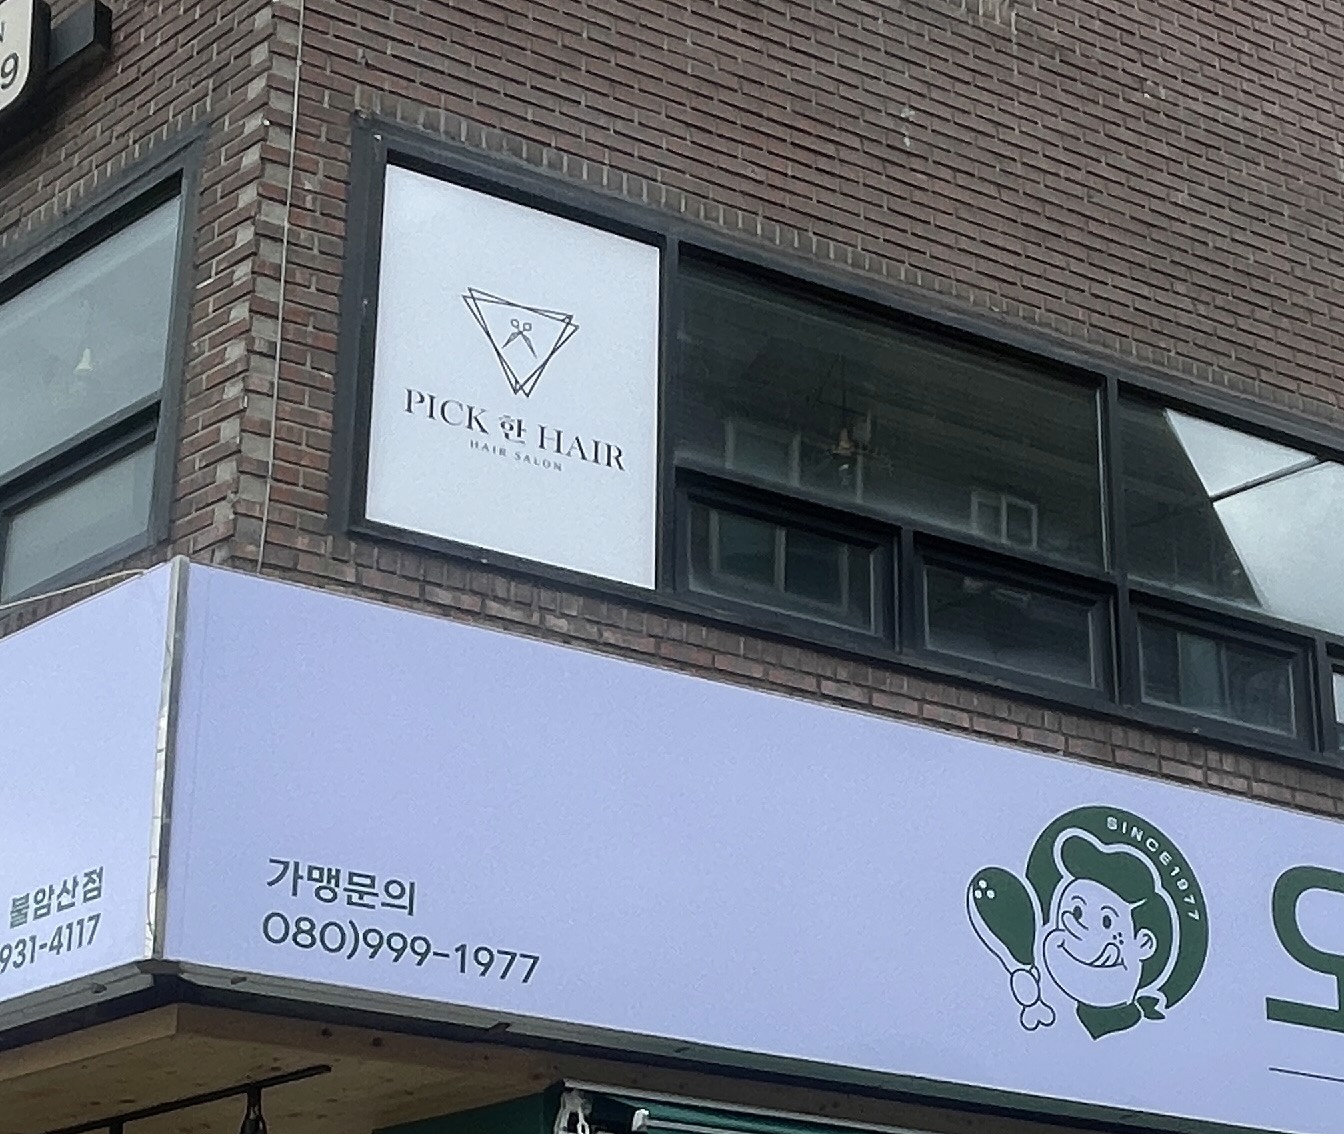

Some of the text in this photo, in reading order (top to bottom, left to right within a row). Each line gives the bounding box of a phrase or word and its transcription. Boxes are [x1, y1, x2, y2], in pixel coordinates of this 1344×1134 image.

[404, 388, 626, 471] PICK 한 HAIR
[470, 439, 563, 472] HAIR SALON
[9, 866, 105, 929] 불암산점
[267, 858, 417, 917] 가맹문의
[263, 912, 540, 984] 080)999-1977
